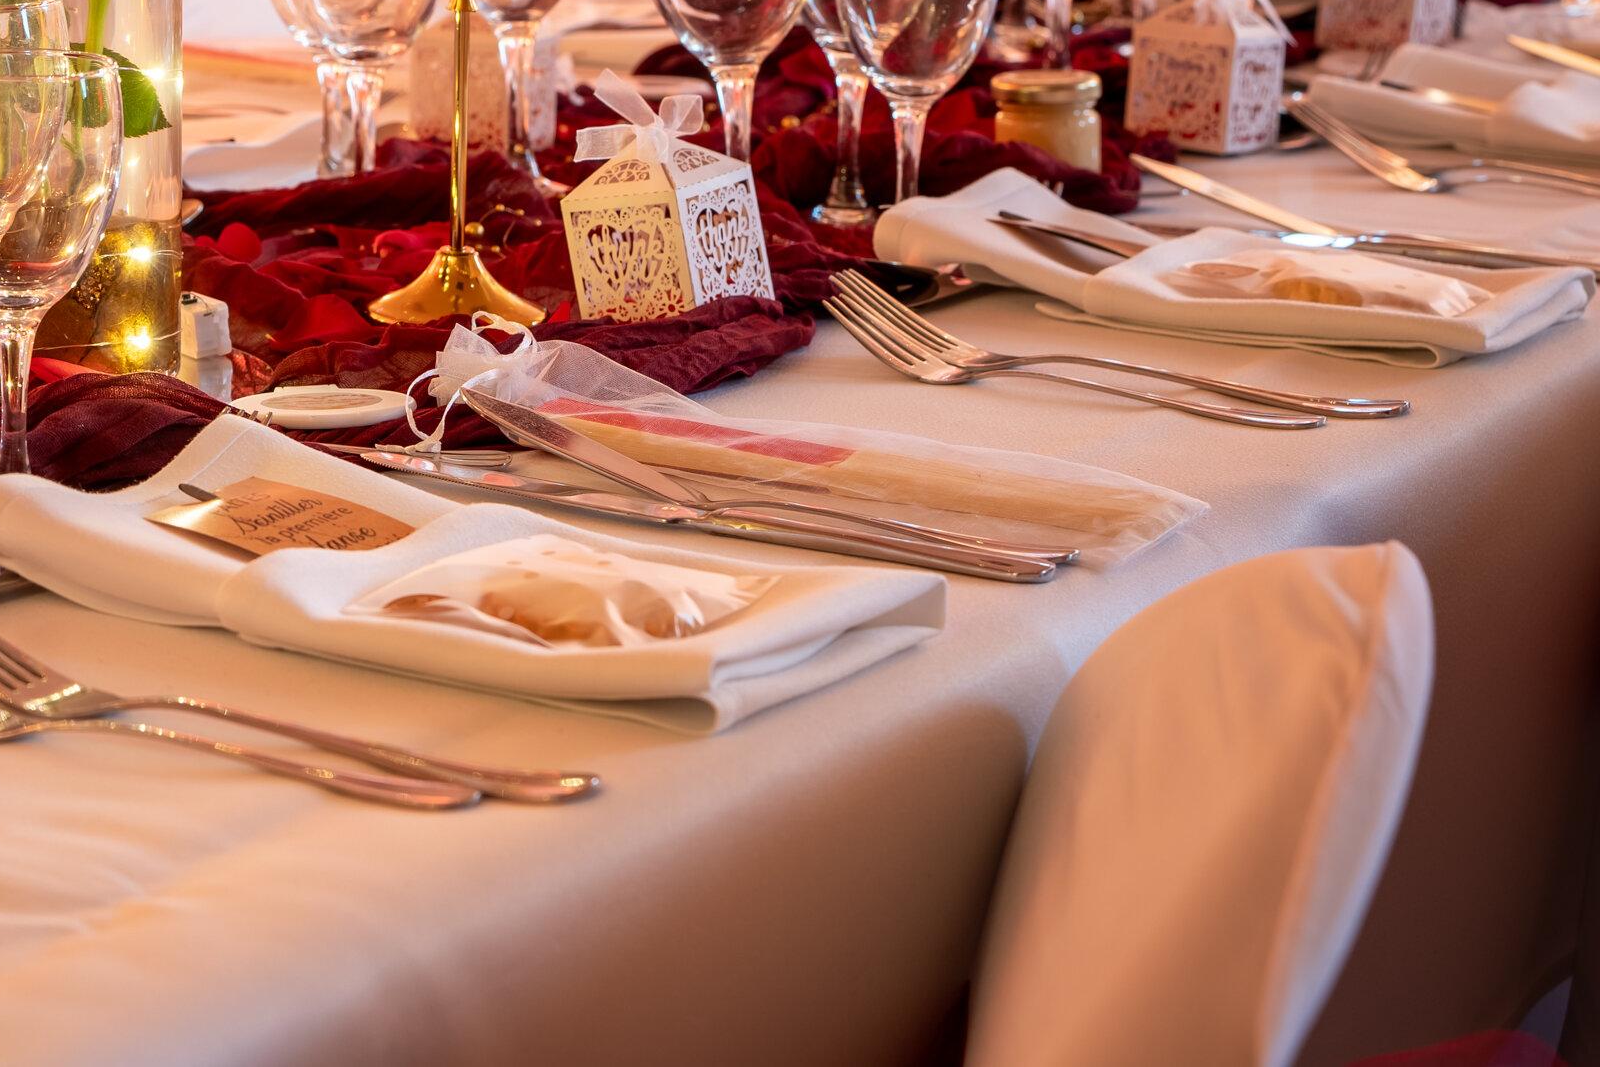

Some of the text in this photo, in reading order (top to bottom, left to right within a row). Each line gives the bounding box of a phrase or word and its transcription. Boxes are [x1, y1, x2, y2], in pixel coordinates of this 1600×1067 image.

[696, 205, 750, 257] thank
[229, 498, 323, 536] Scintiller
[254, 534, 282, 546] la
